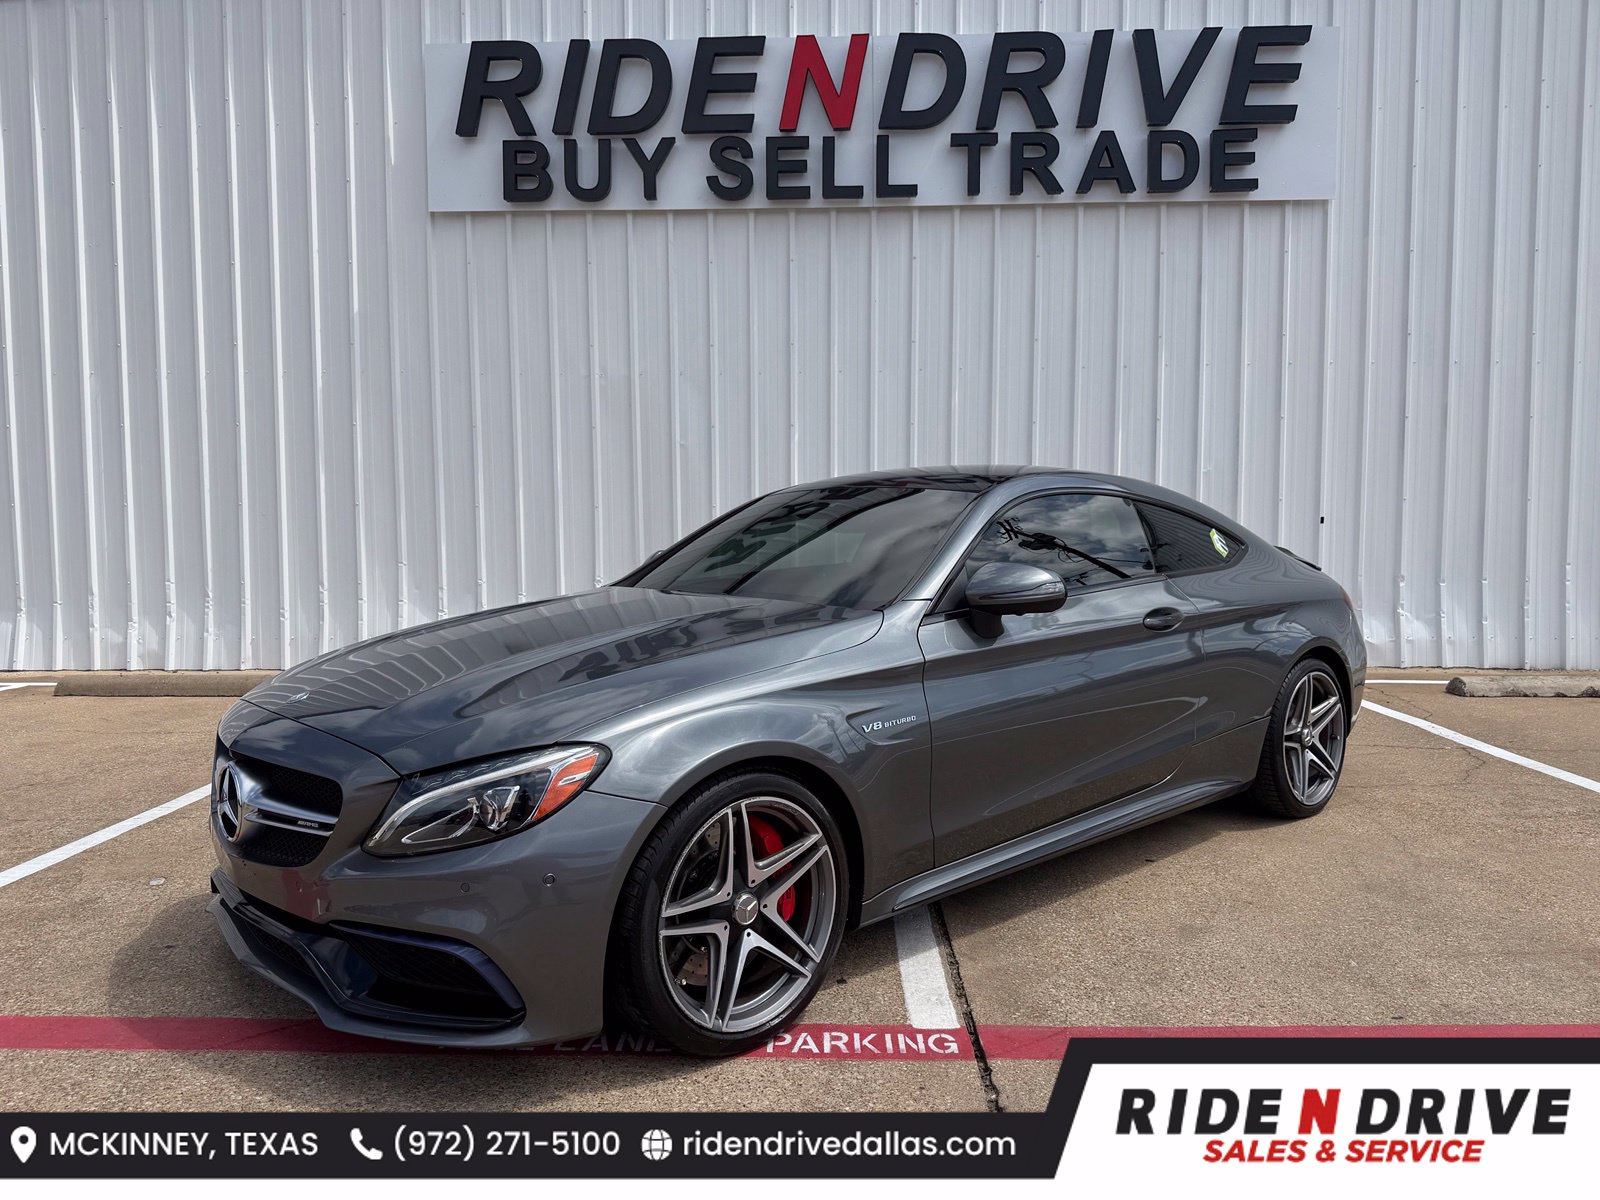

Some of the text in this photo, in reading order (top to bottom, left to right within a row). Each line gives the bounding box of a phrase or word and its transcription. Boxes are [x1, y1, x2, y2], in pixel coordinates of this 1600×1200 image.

[502, 128, 1259, 202] BUY SELL TRADE
[862, 715, 917, 733] V8 BITURBO
[766, 1031, 960, 1054] PARKING
